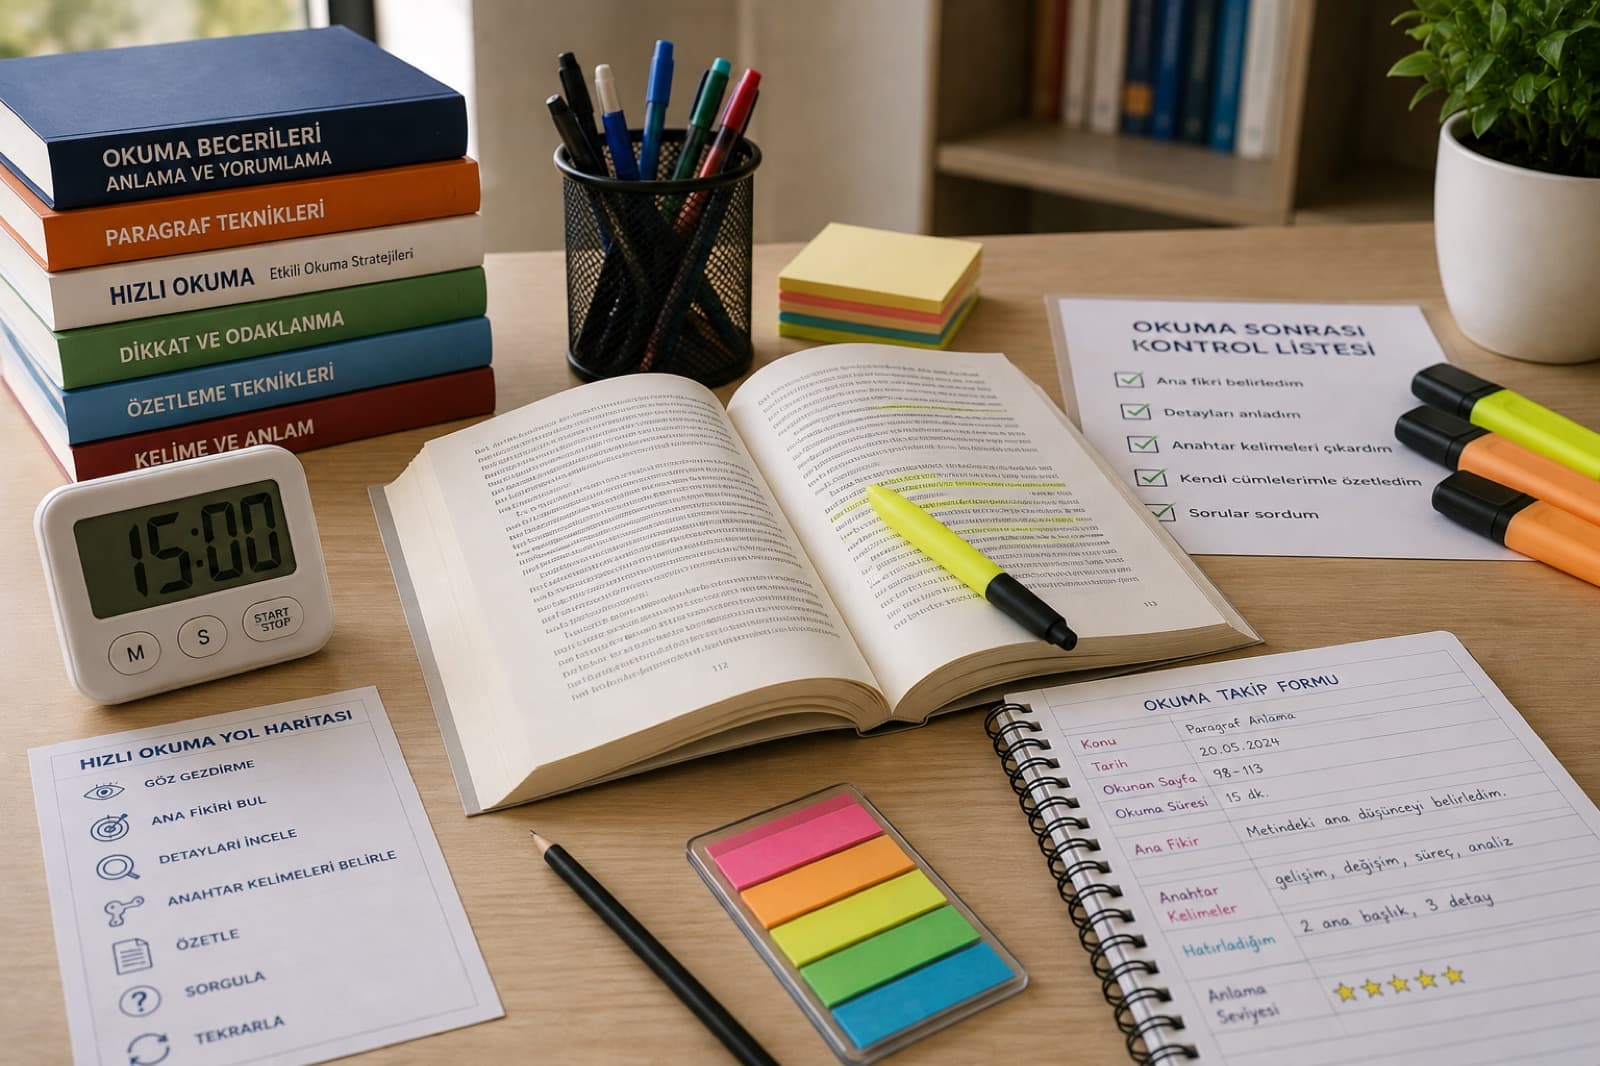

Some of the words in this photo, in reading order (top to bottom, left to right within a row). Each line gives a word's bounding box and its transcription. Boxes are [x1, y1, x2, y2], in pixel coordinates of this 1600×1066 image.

[103, 140, 191, 168] OKUMA
[198, 122, 321, 157] BECERİLERİ
[106, 168, 188, 192] ANLAMA
[192, 164, 214, 182] VE
[219, 151, 332, 178] YORUMLAMA
[105, 217, 212, 246] PARAGRAF
[219, 199, 325, 229] TEKNİKLERİ
[270, 264, 300, 280] Etkili
[304, 260, 348, 274] Okuma
[352, 248, 413, 267] Stratejileri
[110, 281, 166, 305] HIZLI
[173, 268, 255, 296] OKUMA
[120, 336, 190, 364] DİKKAT
[196, 333, 220, 349] VE
[226, 311, 345, 341] ODAKLANMA
[1132, 320, 1236, 335] OKUMA
[1244, 322, 1365, 338] SONRASI
[1132, 339, 1268, 355] KONTROL
[1275, 340, 1376, 357] LİSTESİ
[127, 385, 226, 417] ÖZETLEME
[231, 362, 334, 395] TEKNİKLERİ
[1157, 377, 1187, 386] Ana
[1191, 377, 1222, 386] fikri
[1164, 408, 1234, 419] Detayları
[1239, 409, 1301, 419] anladım
[135, 440, 208, 469] KELİME
[214, 434, 238, 452] VE
[245, 419, 314, 446] ANLAM
[1172, 441, 1236, 451] Anahtar
[1240, 441, 1320, 453] kelimeleri
[1324, 443, 1393, 455] çıkardım
[1179, 473, 1227, 485] Kendi
[1231, 474, 1337, 486] cümlelerimle
[1342, 476, 1422, 487] özetledim
[1189, 508, 1249, 519] Sorular
[1254, 509, 1319, 520] sordum
[129, 492, 281, 597] 15:00
[254, 607, 289, 623] START
[261, 617, 291, 632] STOP
[198, 629, 210, 645] S
[127, 645, 145, 662] M
[1144, 692, 1211, 712] OKUMA
[1216, 682, 1268, 701] TAKİP
[1276, 674, 1340, 693] FORMU
[1185, 718, 1241, 735] Paragraf
[1249, 712, 1296, 725] Anlama
[80, 751, 132, 770] HIZLI
[139, 736, 216, 759] OKUMA
[220, 729, 259, 743] YOL
[264, 710, 353, 735] HARİTASI
[1081, 737, 1117, 749] Konu
[1200, 737, 1280, 757] 20.05.2024
[144, 775, 176, 788] GÖZ
[180, 760, 255, 782] GEZDİRME
[1091, 759, 1128, 772] Tarih
[1103, 780, 1155, 795] Okunan
[1158, 774, 1198, 789] Sayfa
[1115, 805, 1163, 820] Okuma
[1167, 797, 1208, 813] Süresi
[1225, 792, 1241, 803] 15
[152, 811, 185, 825] ANA
[237, 796, 267, 809] BUL
[1246, 817, 1315, 838] Metindeki
[1324, 813, 1350, 826] ana
[1358, 800, 1425, 821] düşünceyi
[1431, 788, 1507, 808] belirledim.
[245, 828, 297, 847] İNCELE
[1134, 843, 1162, 856] Ana
[1166, 837, 1199, 851] Fikir
[1275, 868, 1335, 890] gelişim,
[1344, 855, 1407, 875] değişim,
[1415, 846, 1462, 863] süreç,
[1468, 836, 1514, 853] analiz
[167, 882, 244, 907] ANAHTAR
[248, 860, 335, 890] KELİMELERİ
[339, 850, 397, 870] BELİRLE
[1159, 885, 1219, 904] Anahtar
[1167, 903, 1238, 923] Kelimeler
[1300, 920, 1313, 933] 2
[1322, 917, 1352, 930] ana
[1359, 905, 1417, 924] başlık,
[1425, 898, 1438, 911] 3
[1449, 891, 1495, 909] detay
[176, 929, 240, 951] ÖZETLE
[1182, 933, 1276, 958] Hatırladığım
[185, 971, 266, 998] SORGULA
[1208, 984, 1266, 1003] Anlama
[1217, 1003, 1280, 1026] Seviyesi
[194, 1015, 285, 1045] TEKRARLA
